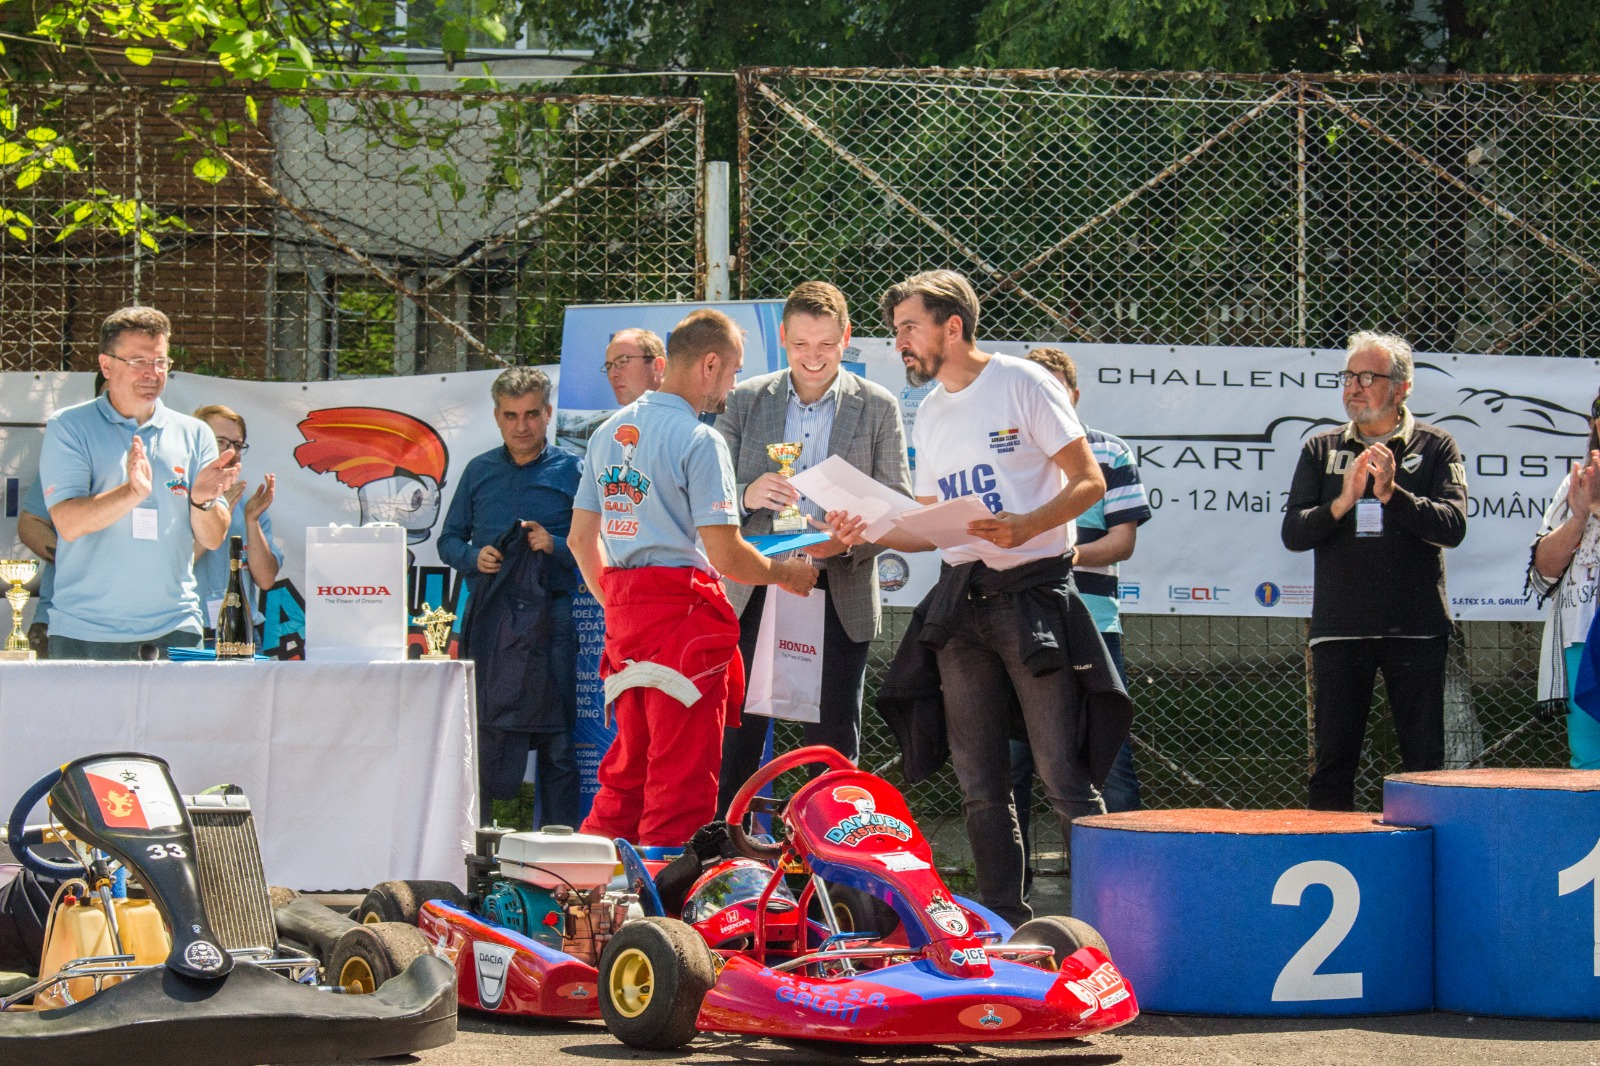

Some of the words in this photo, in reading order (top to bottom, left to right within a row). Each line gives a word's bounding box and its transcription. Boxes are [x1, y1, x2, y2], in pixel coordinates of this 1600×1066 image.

[1098, 367, 1340, 389] CHALLENG
[1137, 445, 1275, 470] KART
[1460, 454, 1584, 477] OST
[982, 492, 1004, 515] 8
[1149, 488, 1163, 510] 0
[1189, 489, 1217, 511] 12
[1226, 490, 1270, 512] Mai
[1467, 491, 1552, 518] OMÂN
[317, 586, 391, 596] HONDA
[779, 639, 817, 655] HONDA
[576, 684, 598, 693] TING
[577, 709, 600, 718] TING
[843, 824, 908, 847] PISTONS
[146, 843, 187, 859] 33
[1558, 838, 1600, 976] 1
[720, 918, 751, 934] HONDA
[1271, 860, 1363, 1002] 2
[479, 952, 503, 965] DACIA
[965, 949, 986, 959] ICE
[775, 985, 861, 1024] GALATI
